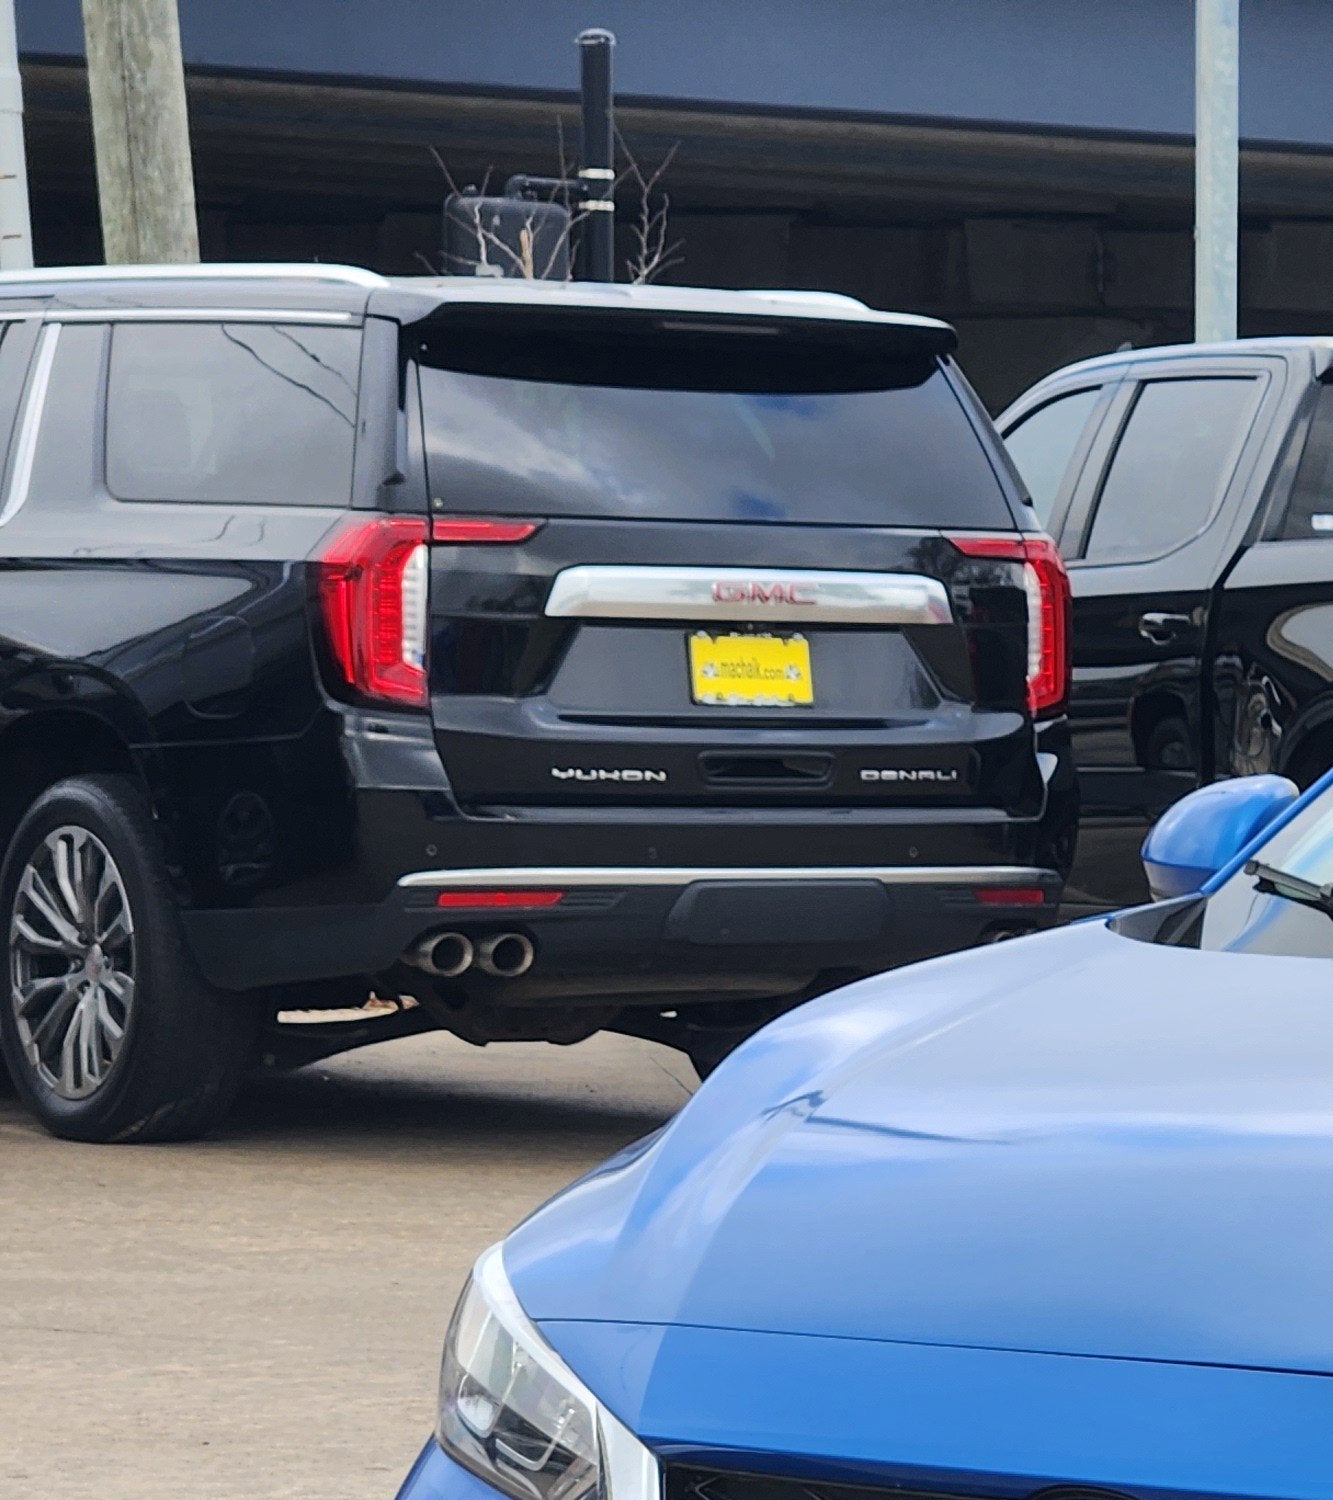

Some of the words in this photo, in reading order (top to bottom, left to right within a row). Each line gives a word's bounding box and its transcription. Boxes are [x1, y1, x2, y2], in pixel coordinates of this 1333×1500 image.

[712, 580, 819, 606] GMC
[551, 767, 668, 782] YUKON
[859, 769, 957, 781] DENALI
